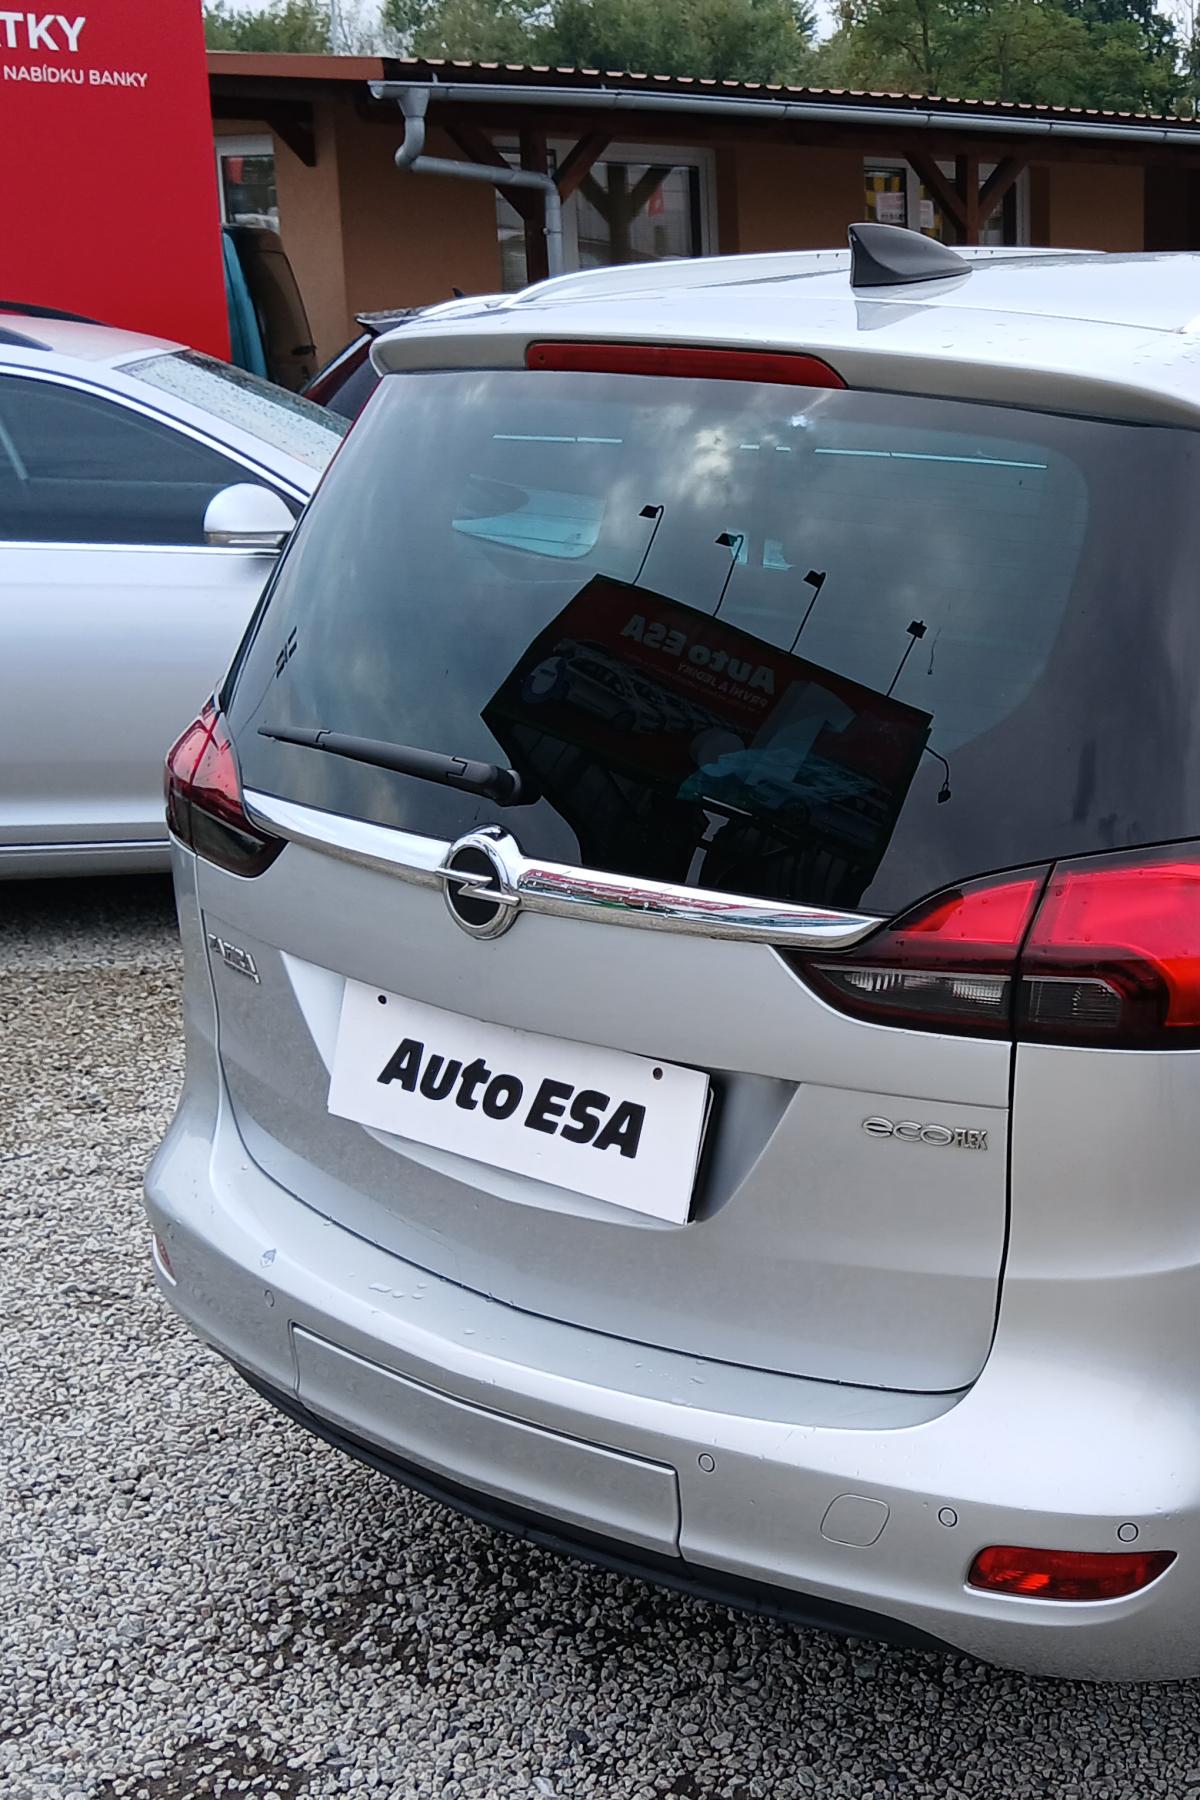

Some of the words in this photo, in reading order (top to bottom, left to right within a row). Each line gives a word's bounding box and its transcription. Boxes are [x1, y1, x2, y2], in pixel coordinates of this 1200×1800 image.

[0, 11, 86, 51] TKY
[3, 64, 84, 84] NABÍDKU
[89, 70, 148, 88] BANKY
[376, 1038, 523, 1120] Auto
[524, 1078, 646, 1159] ESA
